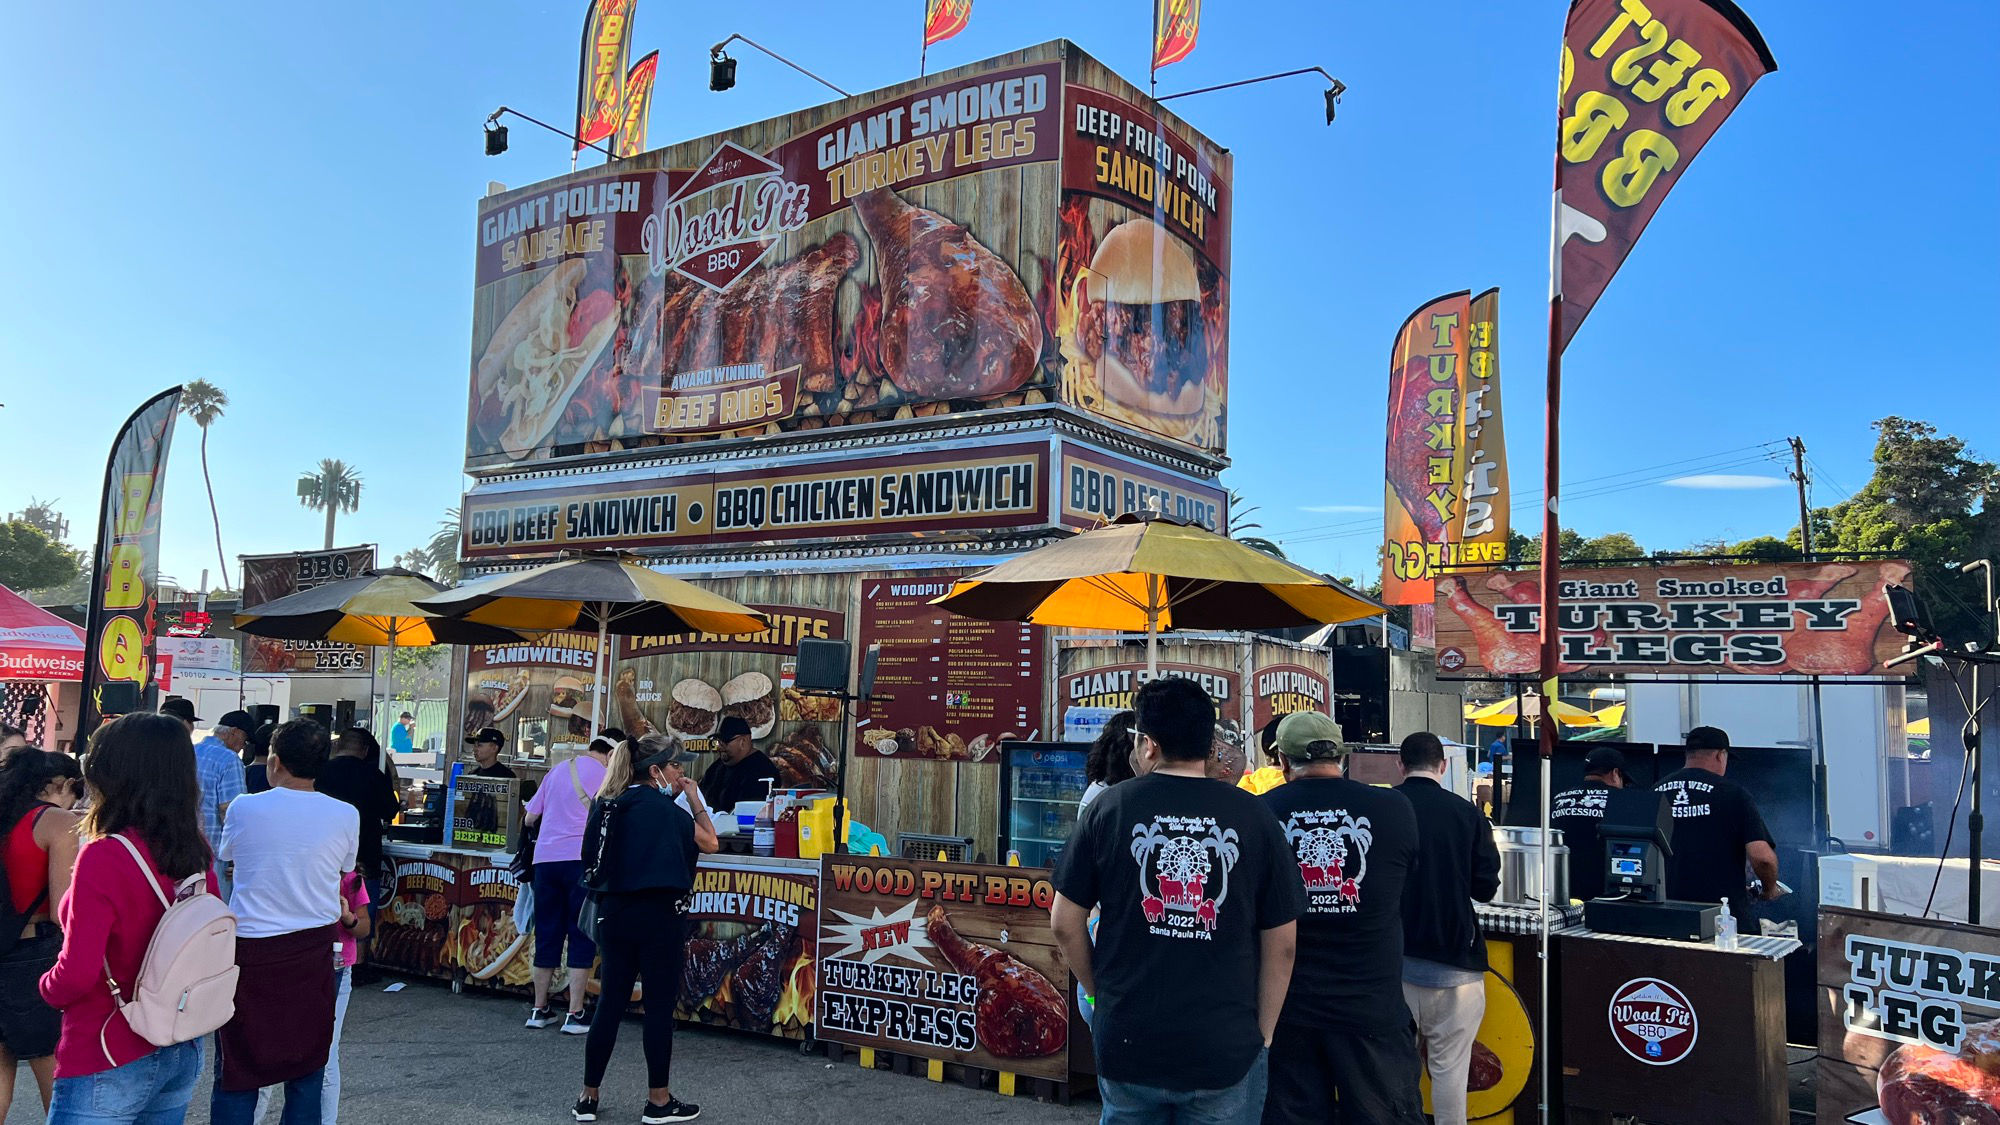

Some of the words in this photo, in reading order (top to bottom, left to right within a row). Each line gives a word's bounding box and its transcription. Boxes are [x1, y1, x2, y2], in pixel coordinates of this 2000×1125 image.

[594, 14, 626, 107] BBQ
[817, 106, 906, 171] GIANT
[910, 74, 1047, 137] SMOKED
[827, 133, 950, 206] TURKEY
[955, 118, 1036, 168] LEGS
[1076, 103, 1121, 138] DEEP
[1125, 122, 1172, 172] FRIED
[1176, 153, 1217, 213] PORK
[1095, 145, 1205, 240] SANDWICH
[482, 197, 550, 248] GIANT
[553, 181, 641, 222] POLISH
[641, 180, 746, 277] Wood
[751, 174, 809, 233] Pit
[501, 220, 606, 274] SAUSAGE
[707, 249, 741, 273] BBQ
[671, 369, 713, 391] AWARD
[714, 363, 766, 383] WINNING
[653, 394, 717, 429] BEEF
[720, 381, 783, 425] RIBS
[715, 486, 765, 530] BBQ
[770, 474, 875, 525] CHICKEN
[880, 462, 1034, 519] SANDWICH
[1069, 463, 1117, 520] BBQ
[470, 509, 509, 546] BBQ
[512, 504, 560, 542] BEEF
[565, 493, 678, 540] SANDWICH
[296, 554, 351, 580] BBQ
[98, 472, 152, 692] BBQ
[890, 583, 944, 596] WOODPIT
[1559, 578, 1638, 600] Giant
[1657, 575, 1787, 598] Smoked
[1494, 600, 1862, 633] TURKEY
[0, 630, 74, 640] udweiser
[0, 651, 84, 672] Budweise
[315, 651, 365, 669] LEGS
[486, 646, 593, 668] SANDWICHES
[1559, 634, 1788, 666] LEGS
[636, 692, 661, 702] SAUCE
[639, 680, 653, 690] BBQ
[1070, 671, 1131, 699] GIANT
[1259, 672, 1289, 697] GIANT
[1290, 672, 1324, 704] POLISH
[684, 739, 709, 751] PORK
[1044, 753, 1068, 765] pepsi
[457, 781, 481, 792] HALF
[483, 783, 509, 794] RACK
[1586, 788, 1609, 796] WES
[1688, 780, 1715, 793] WEST
[453, 818, 474, 829] BBQ
[454, 830, 481, 842] BEEF
[482, 832, 507, 845] RIBS
[398, 862, 423, 877] AWARD
[424, 863, 455, 885] WINNING
[406, 875, 425, 889] BEEF
[425, 877, 444, 893] RIBS
[470, 869, 497, 886] GIANT
[692, 872, 730, 892] ARD
[735, 872, 816, 911] WINNING
[832, 864, 915, 897] WOOD
[921, 871, 978, 901] PIT
[985, 875, 1055, 911] BBQ
[1311, 895, 1339, 905] 2022
[688, 892, 750, 916] URKEY
[753, 896, 800, 927] LEGS
[1167, 915, 1195, 928] 2022
[1318, 906, 1340, 914] Paula
[1341, 905, 1358, 914] FFA
[861, 920, 911, 951] NEW
[1000, 930, 1009, 943] $
[1149, 926, 1171, 938] Santa
[1172, 928, 1194, 939] Paula
[1195, 930, 1212, 941] FFA
[823, 958, 921, 998] TURKEY
[925, 971, 978, 1006] LEG
[1845, 934, 2000, 1009] TURK
[822, 992, 977, 1051] EXPRESS
[1614, 1005, 1662, 1023] Wood
[1665, 1007, 1690, 1026] Pit
[1843, 983, 1967, 1054] LEG
[1638, 1025, 1667, 1039] BBQ
